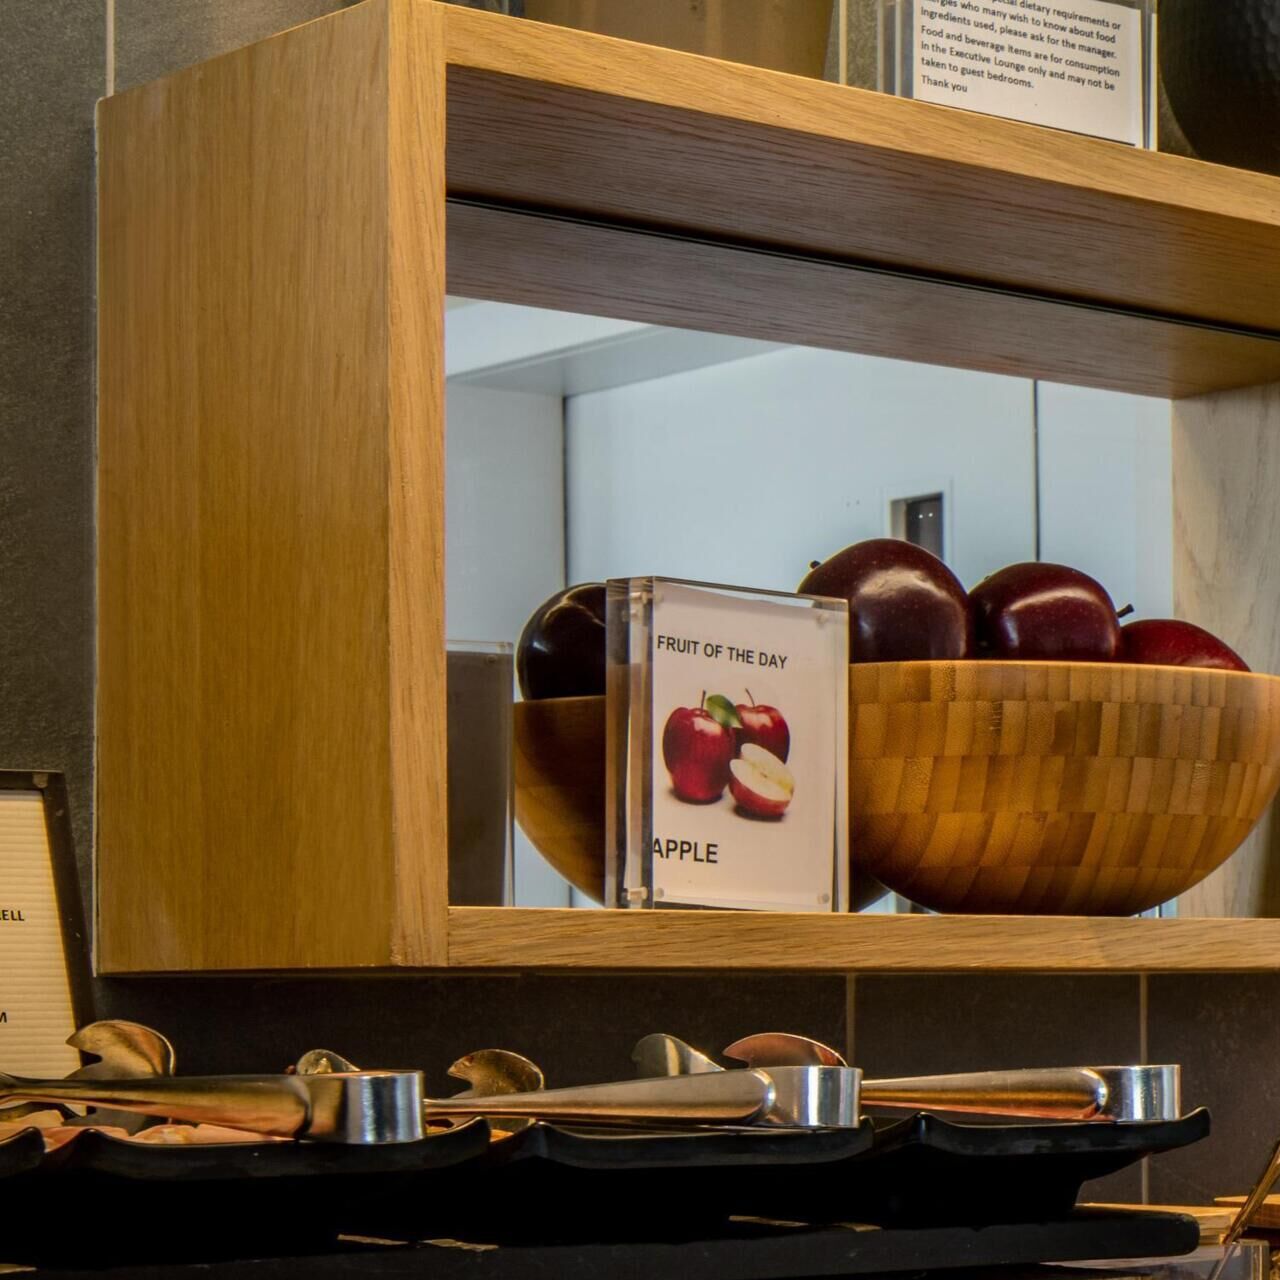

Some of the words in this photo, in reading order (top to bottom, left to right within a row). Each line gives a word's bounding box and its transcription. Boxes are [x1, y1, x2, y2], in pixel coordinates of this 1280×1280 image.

[921, 6, 971, 26] ingredients
[973, 20, 997, 33] used,
[999, 25, 1028, 39] please
[1030, 33, 1045, 42] ask
[1047, 34, 1060, 45] for
[1062, 39, 1077, 50] the
[1078, 43, 1117, 59] manager.
[960, 1, 980, 12] who
[982, 7, 1007, 20] many
[1008, 13, 1029, 24] wish
[1031, 17, 1041, 26] to
[1043, 18, 1067, 32] know
[1069, 25, 1094, 38] about
[1096, 31, 1116, 43] food
[1019, 0, 1051, 15] dietary
[1053, 8, 1110, 28] requirements
[1111, 22, 1121, 31] or
[921, 25, 944, 38] Food
[945, 32, 963, 42] and
[964, 34, 1005, 53] beverage
[1007, 44, 1032, 58] items
[1033, 51, 1048, 61] are
[1050, 53, 1063, 64] for
[1064, 58, 1120, 77] consumption
[931, 43, 947, 54] the
[949, 46, 991, 64] Executive
[994, 56, 1026, 72] Lounge
[1027, 65, 1047, 78] only
[1049, 70, 1066, 80] and
[1067, 73, 1086, 87] may
[1087, 78, 1102, 89] not
[1104, 79, 1115, 91] be
[921, 57, 947, 70] taken
[948, 63, 959, 73] to
[960, 66, 985, 78] guest
[987, 69, 1034, 89] bedrooms.
[921, 74, 950, 89] Thank
[951, 82, 968, 93] you
[656, 634, 700, 656] FRUIT
[703, 642, 724, 660] OF
[727, 646, 755, 665] THE
[758, 651, 788, 670] DAY
[653, 838, 718, 863] APPLE
[0, 909, 25, 921] ELL
